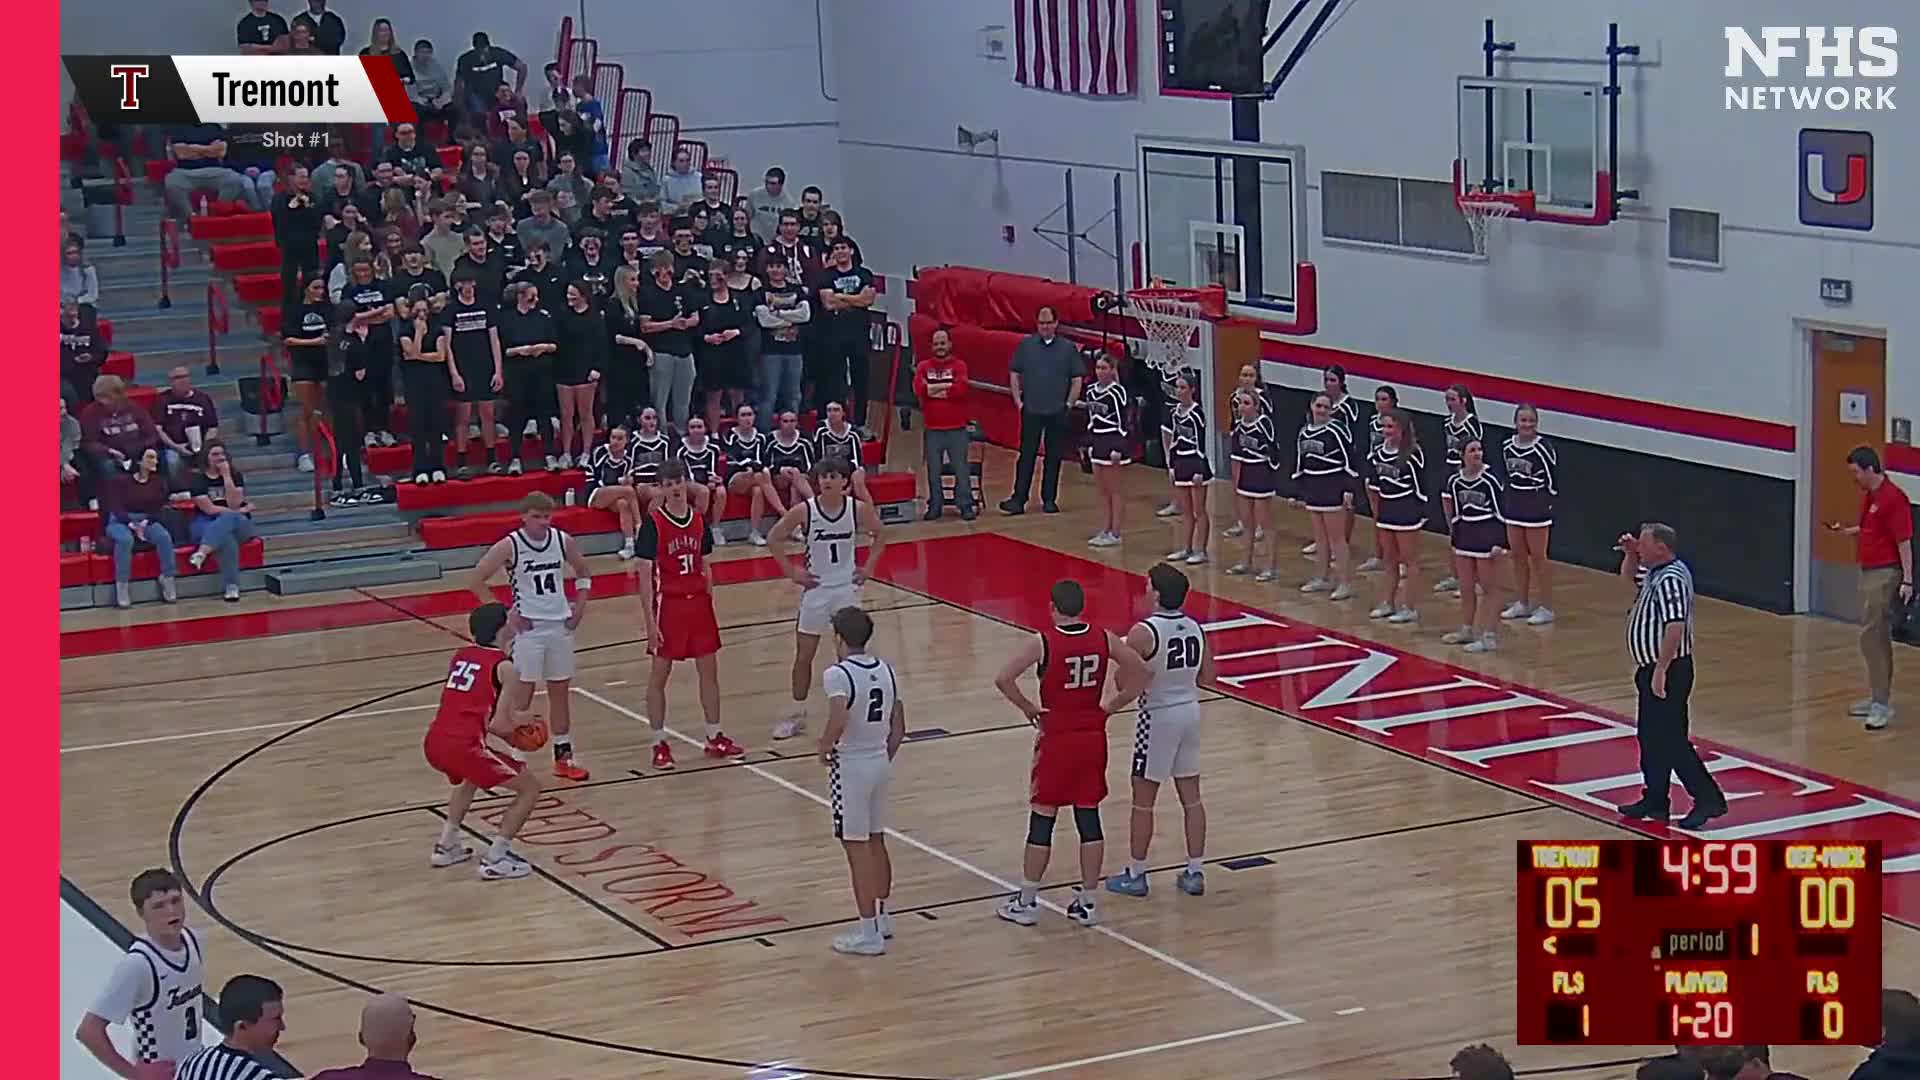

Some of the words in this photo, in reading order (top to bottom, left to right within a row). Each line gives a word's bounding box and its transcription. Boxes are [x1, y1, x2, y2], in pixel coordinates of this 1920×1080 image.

[1805, 152, 1868, 204] U
[678, 554, 694, 575] 31
[830, 543, 838, 564] 1
[534, 573, 556, 595] 14
[1167, 636, 1200, 670] 20
[446, 660, 481, 692] 25
[1064, 654, 1099, 689] 32
[867, 688, 883, 722] 2
[553, 845, 789, 937] STORM
